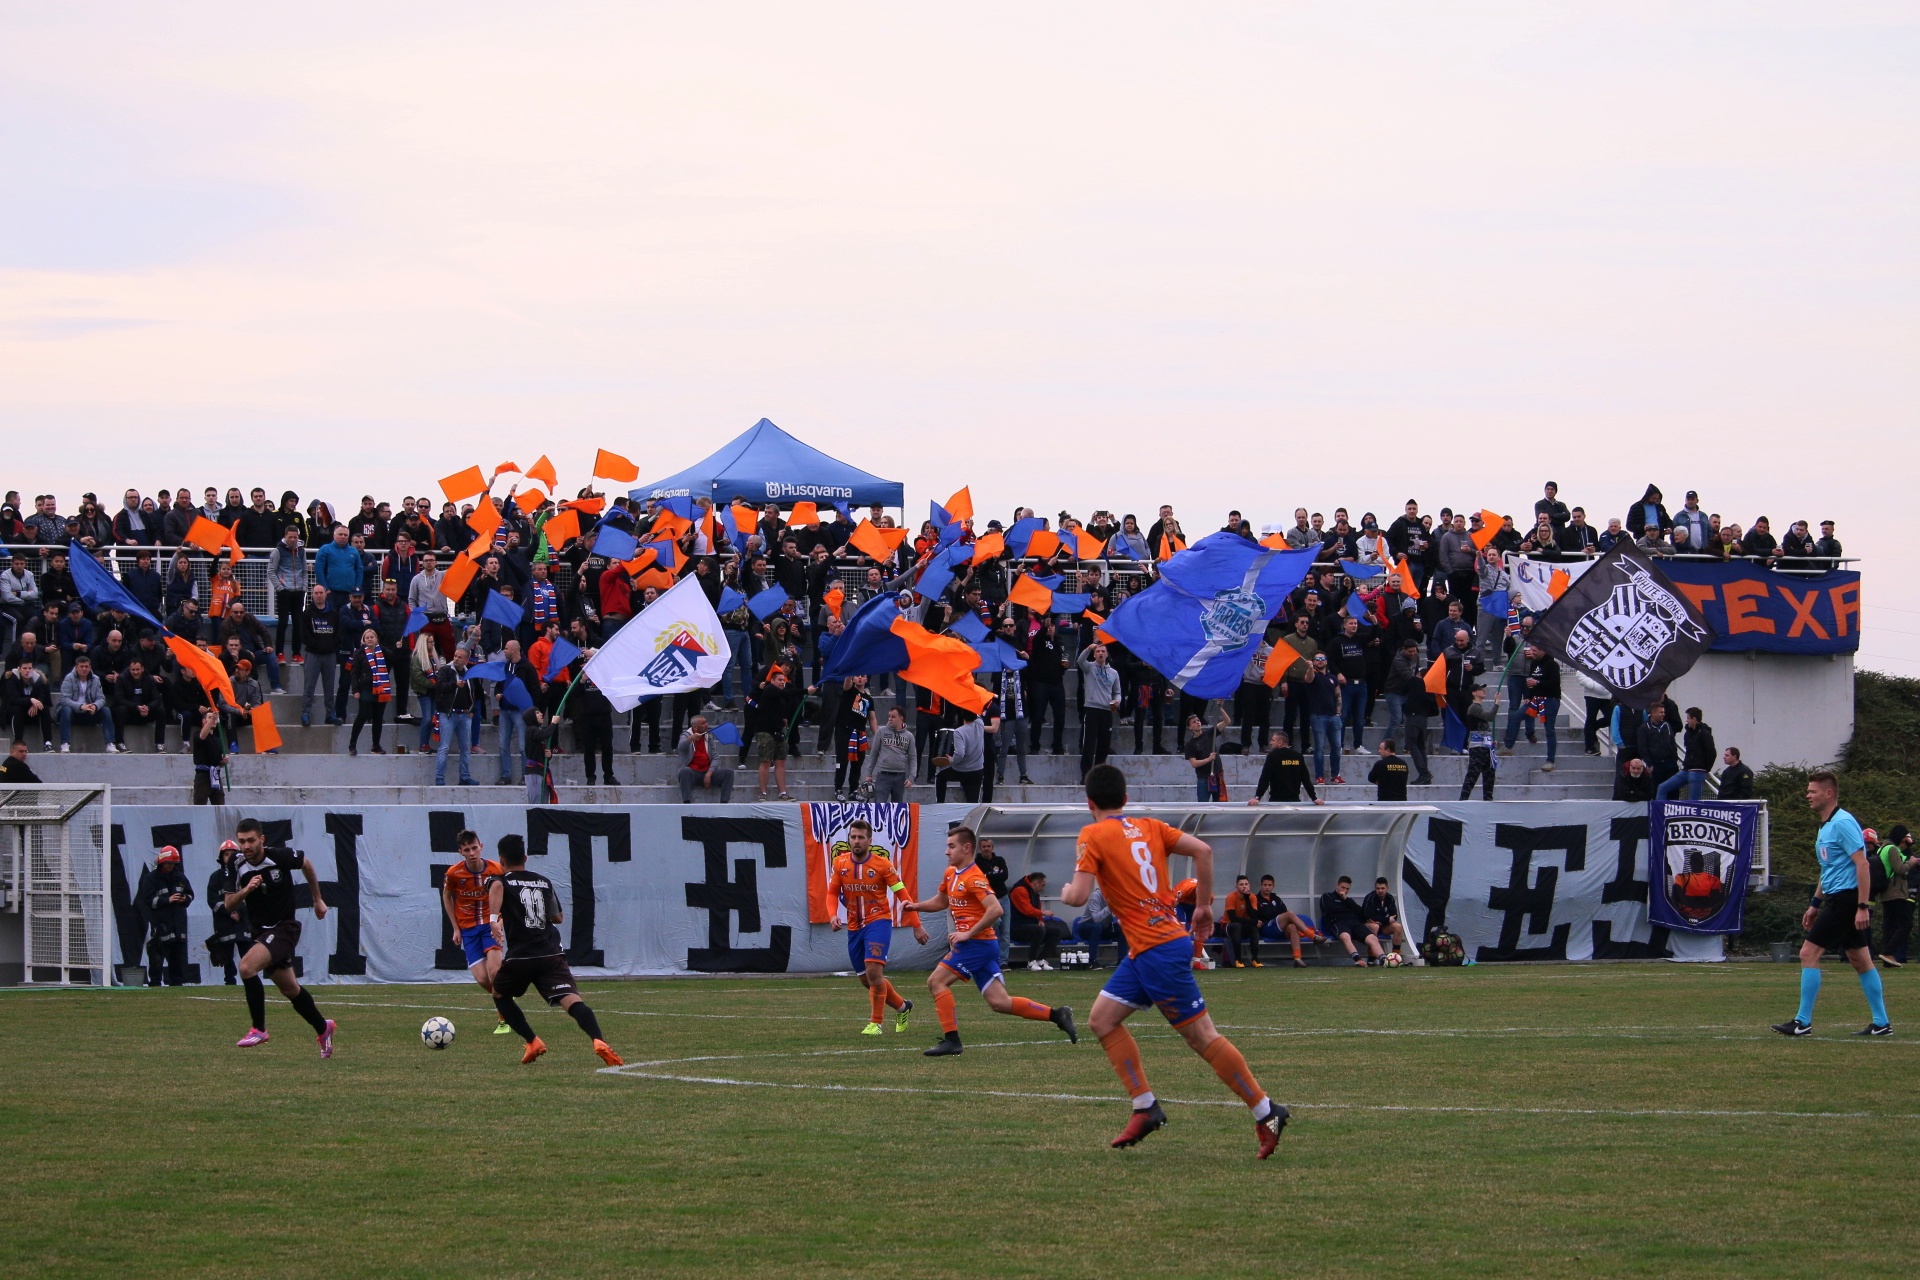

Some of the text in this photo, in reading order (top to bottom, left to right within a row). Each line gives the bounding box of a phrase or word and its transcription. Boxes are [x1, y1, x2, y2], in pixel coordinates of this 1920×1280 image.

[781, 484, 853, 498] Husqvarna
[1633, 572, 1658, 597] WHITE
[1656, 594, 1686, 622] STONES
[1213, 601, 1253, 636] VARTEKS
[677, 632, 690, 646] N
[1664, 803, 1742, 825] WHITE STONES
[1669, 822, 1735, 847] BRONX
[1130, 841, 1158, 894] 8
[519, 886, 547, 930] 11
